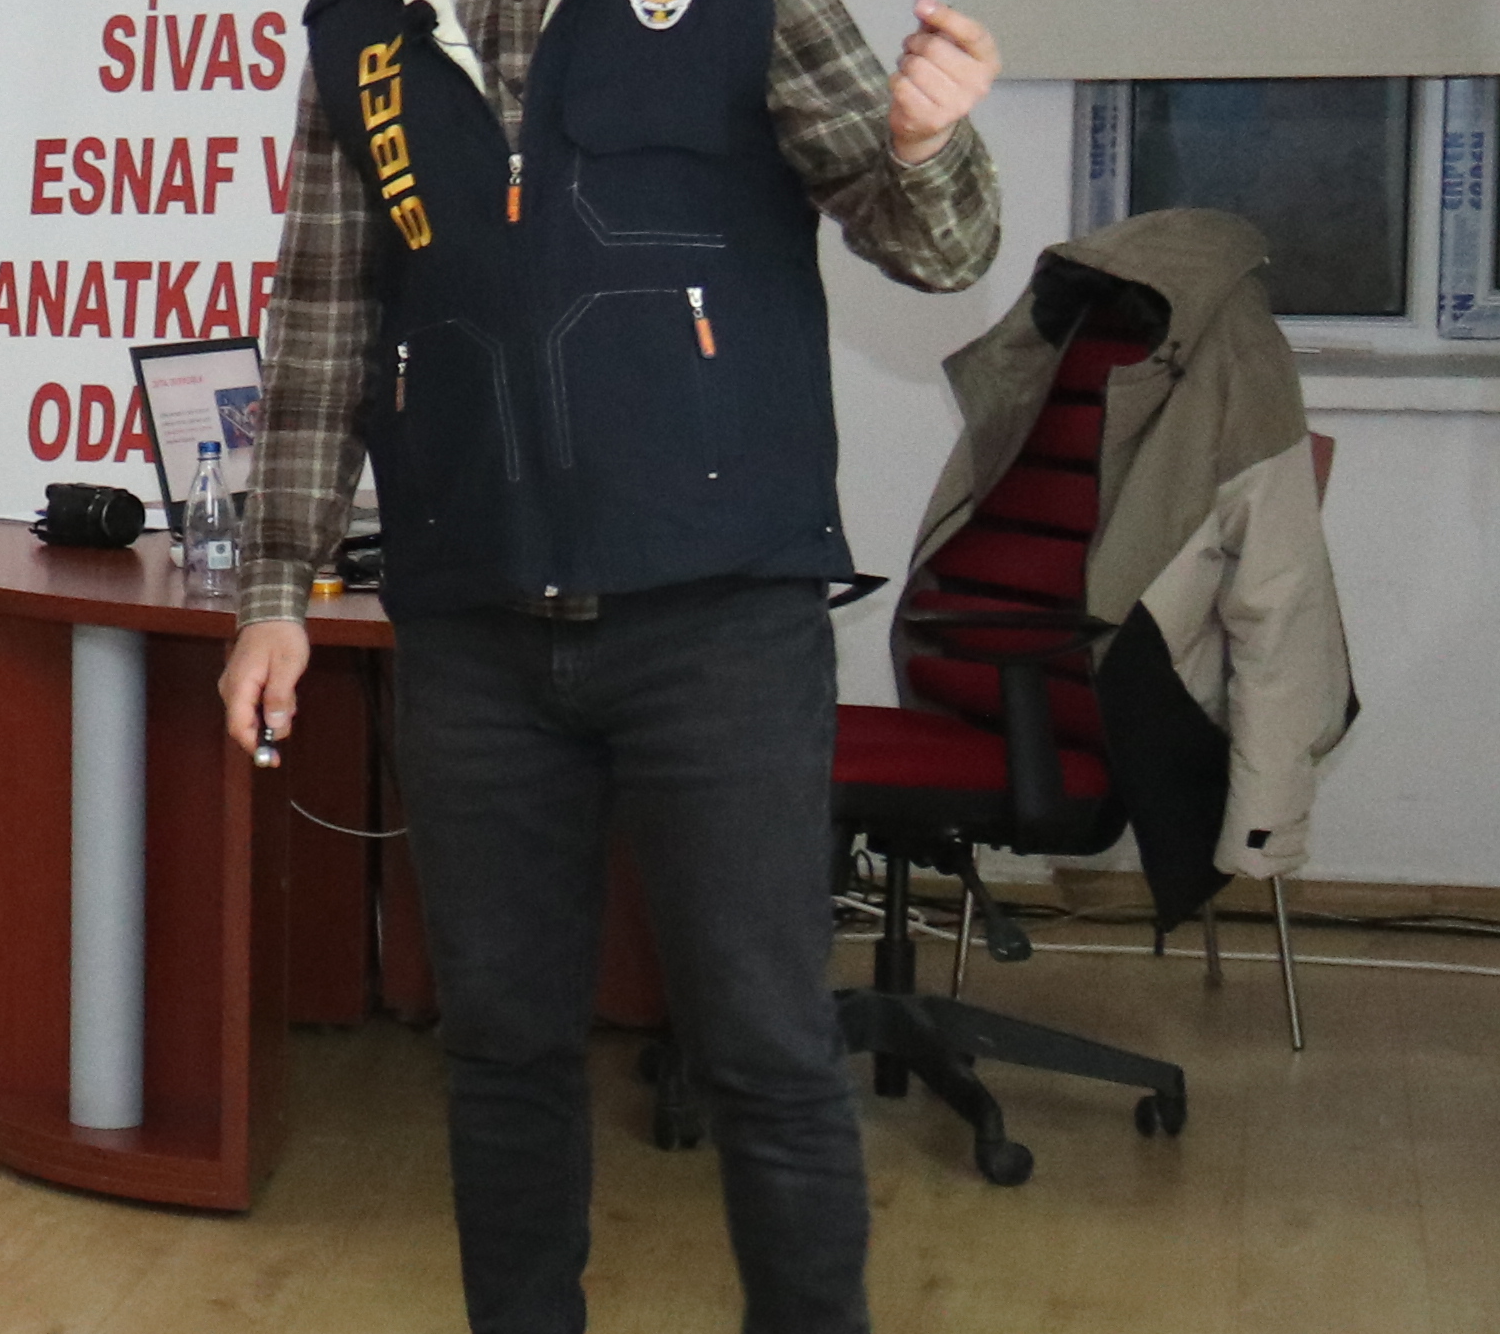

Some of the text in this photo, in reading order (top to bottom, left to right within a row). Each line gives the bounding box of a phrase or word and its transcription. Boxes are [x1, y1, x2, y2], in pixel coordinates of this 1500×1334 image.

[30, 136, 296, 215] ESNAF V
[28, 381, 157, 463] ODA
